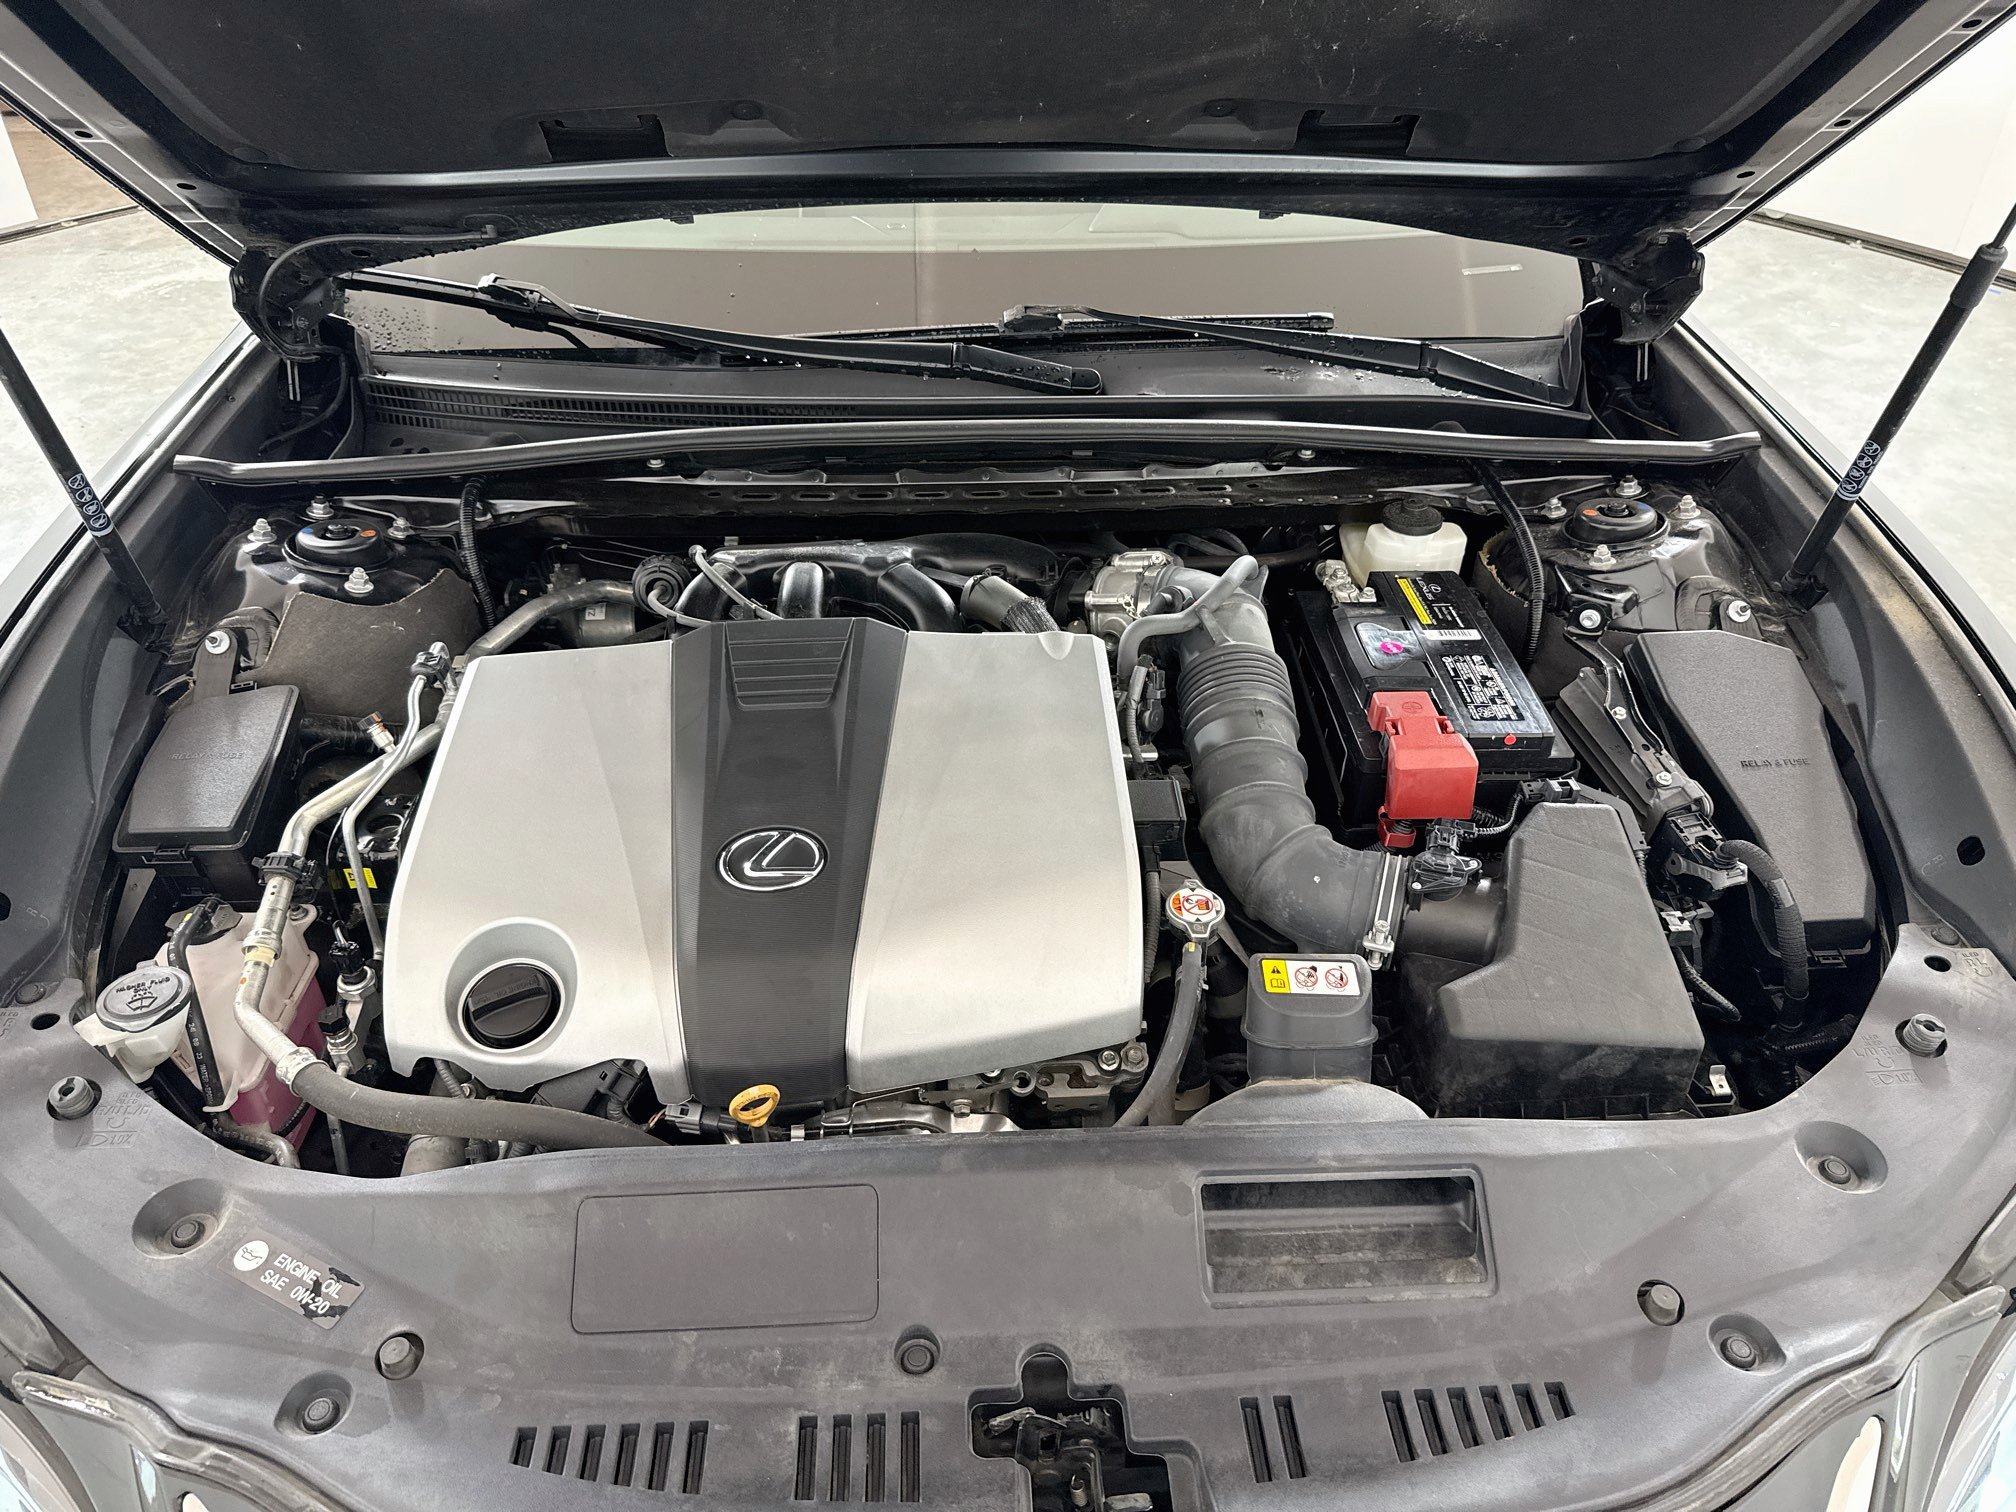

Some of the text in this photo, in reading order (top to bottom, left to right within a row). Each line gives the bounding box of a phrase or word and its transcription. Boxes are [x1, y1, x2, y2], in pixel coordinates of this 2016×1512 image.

[1416, 577, 1435, 600] LEXUS
[1740, 759, 1772, 768] RELAY
[1783, 757, 1809, 767] FUSE
[260, 1269, 331, 1314] SAE 0W-20
[273, 1253, 343, 1299] ENGINE OIL
